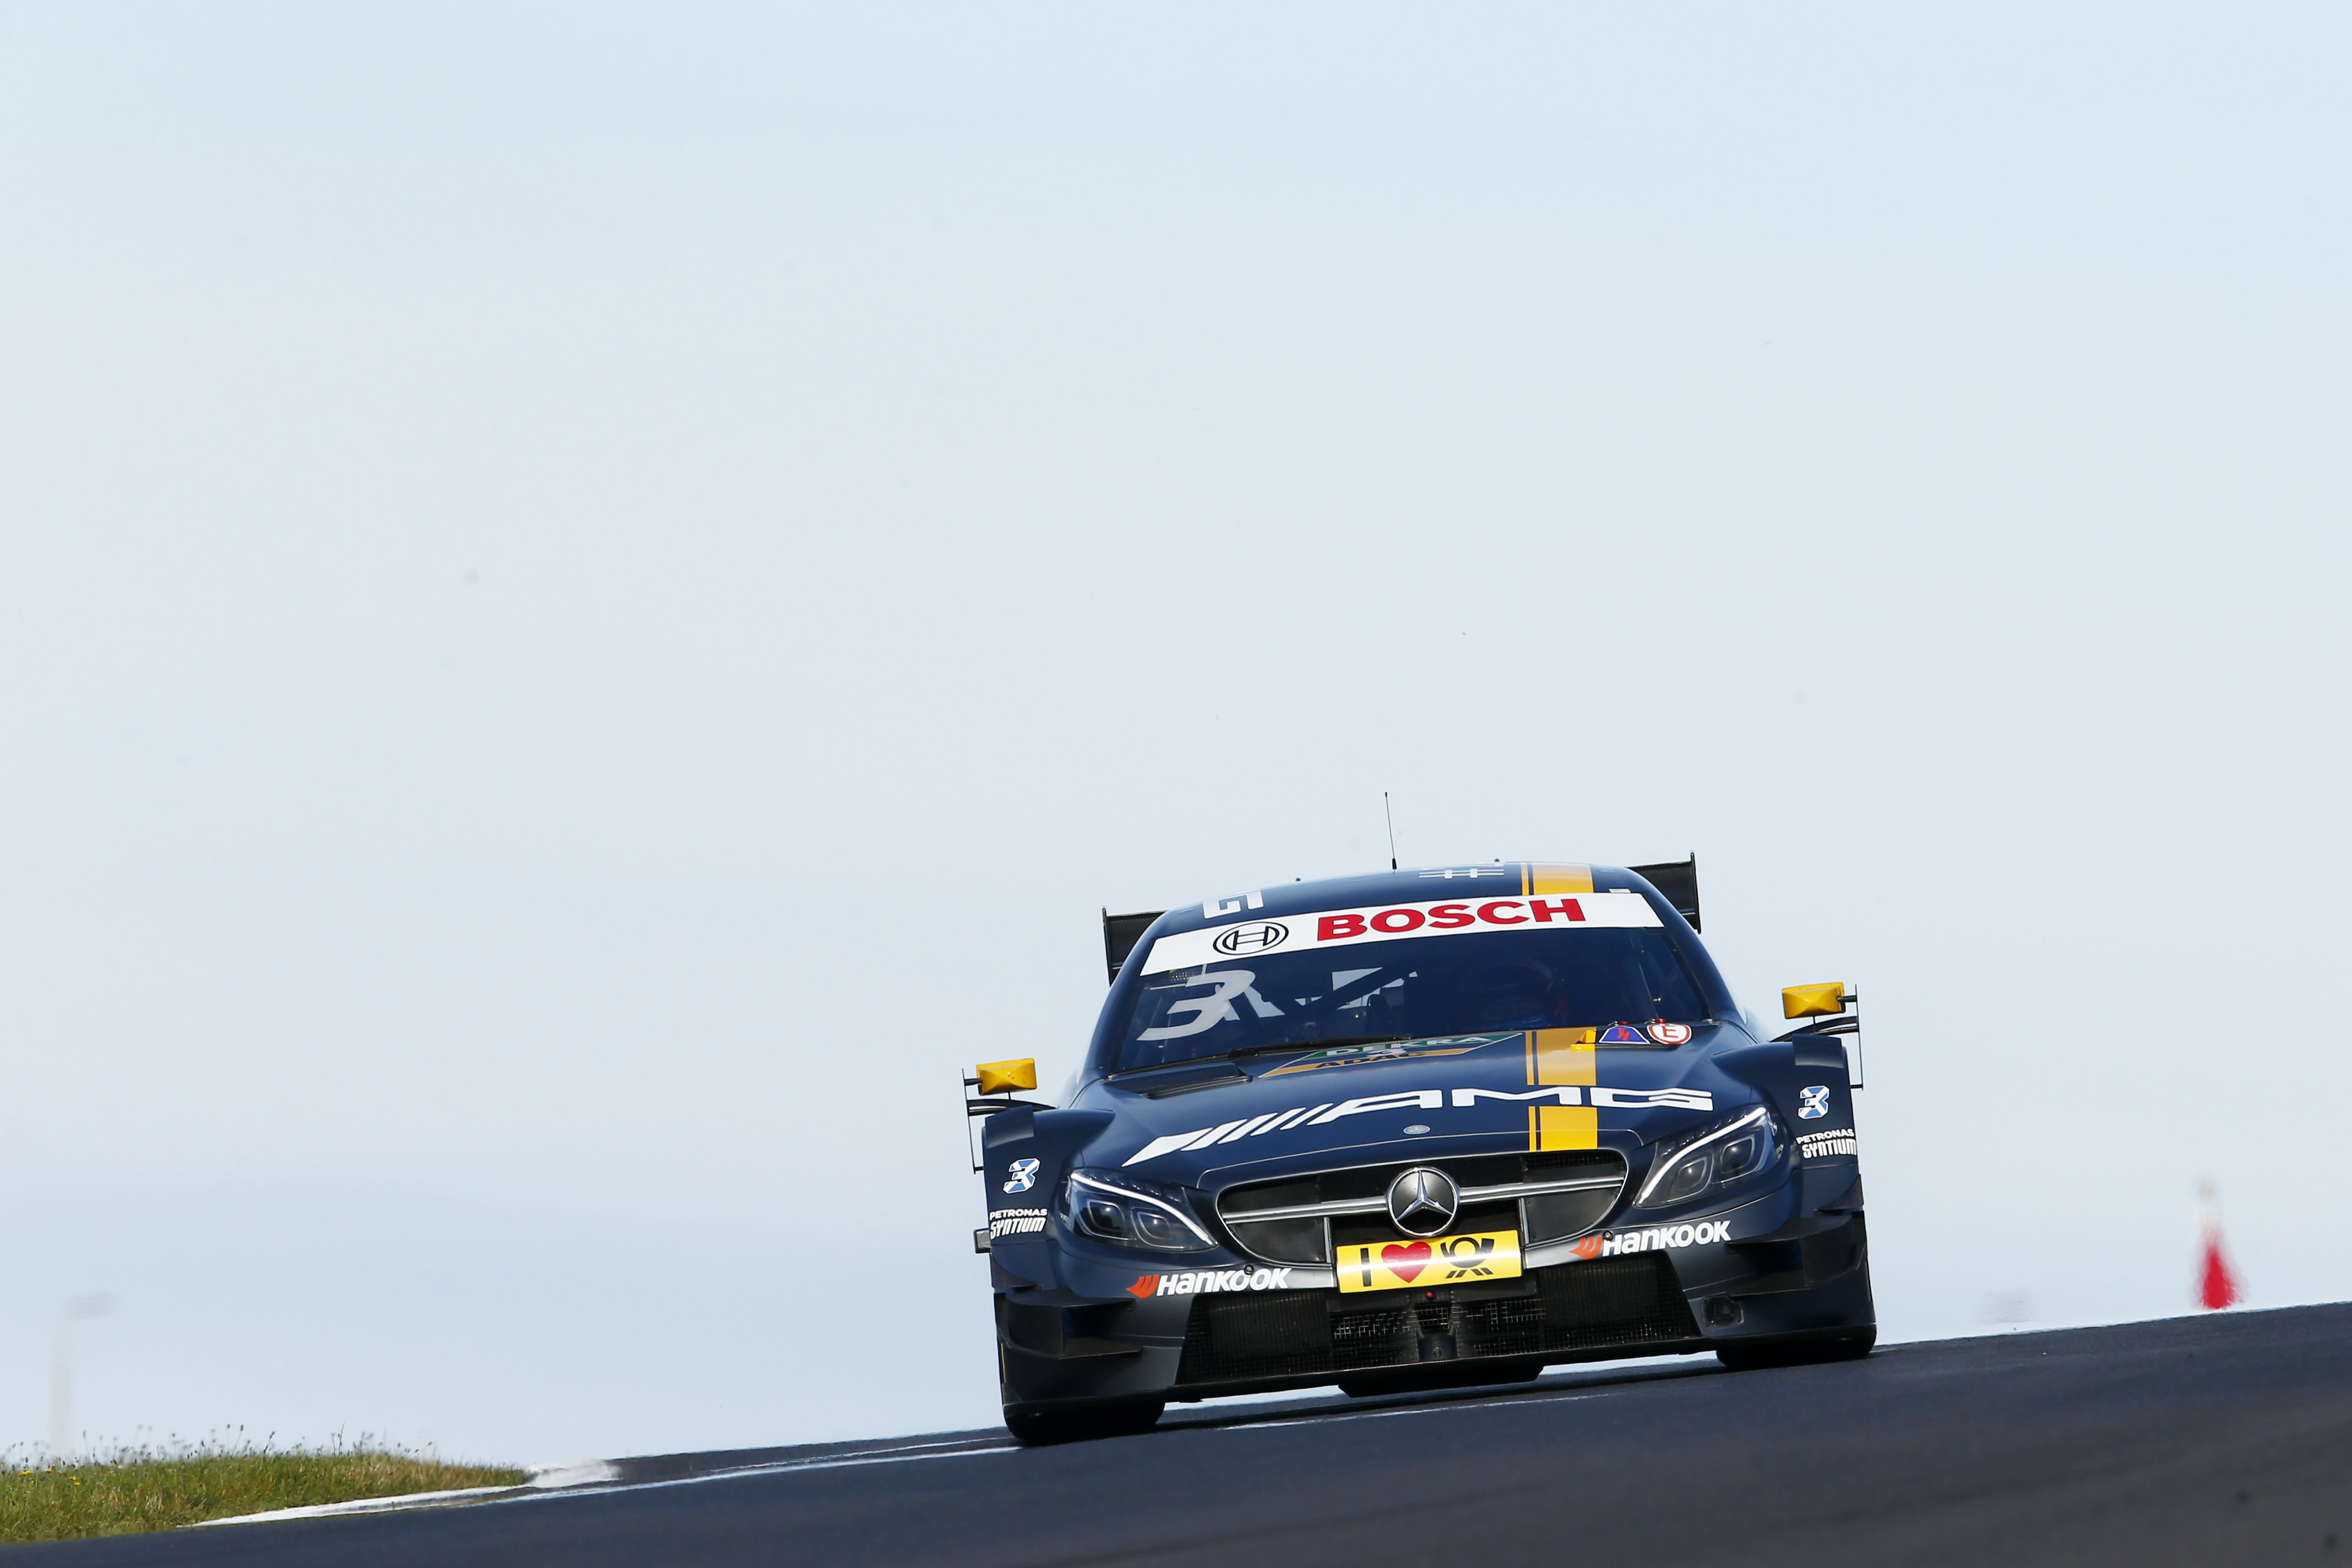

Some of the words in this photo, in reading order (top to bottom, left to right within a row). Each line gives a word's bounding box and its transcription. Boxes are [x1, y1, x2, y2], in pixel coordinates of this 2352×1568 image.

[1317, 898, 1586, 941] BOSCH
[1136, 970, 1256, 1041] 3
[1315, 1052, 1425, 1068] ADAC
[1307, 1086, 1714, 1126] AMG
[1798, 1085, 1830, 1119] 3
[1795, 1128, 1855, 1145] PETRONAS
[1801, 1138, 1857, 1159] SYNTIUM
[1003, 1158, 1041, 1194] 3
[989, 1208, 1048, 1221] PETRONAS
[990, 1217, 1047, 1240] SYNTIUM
[1359, 1248, 1372, 1287] I
